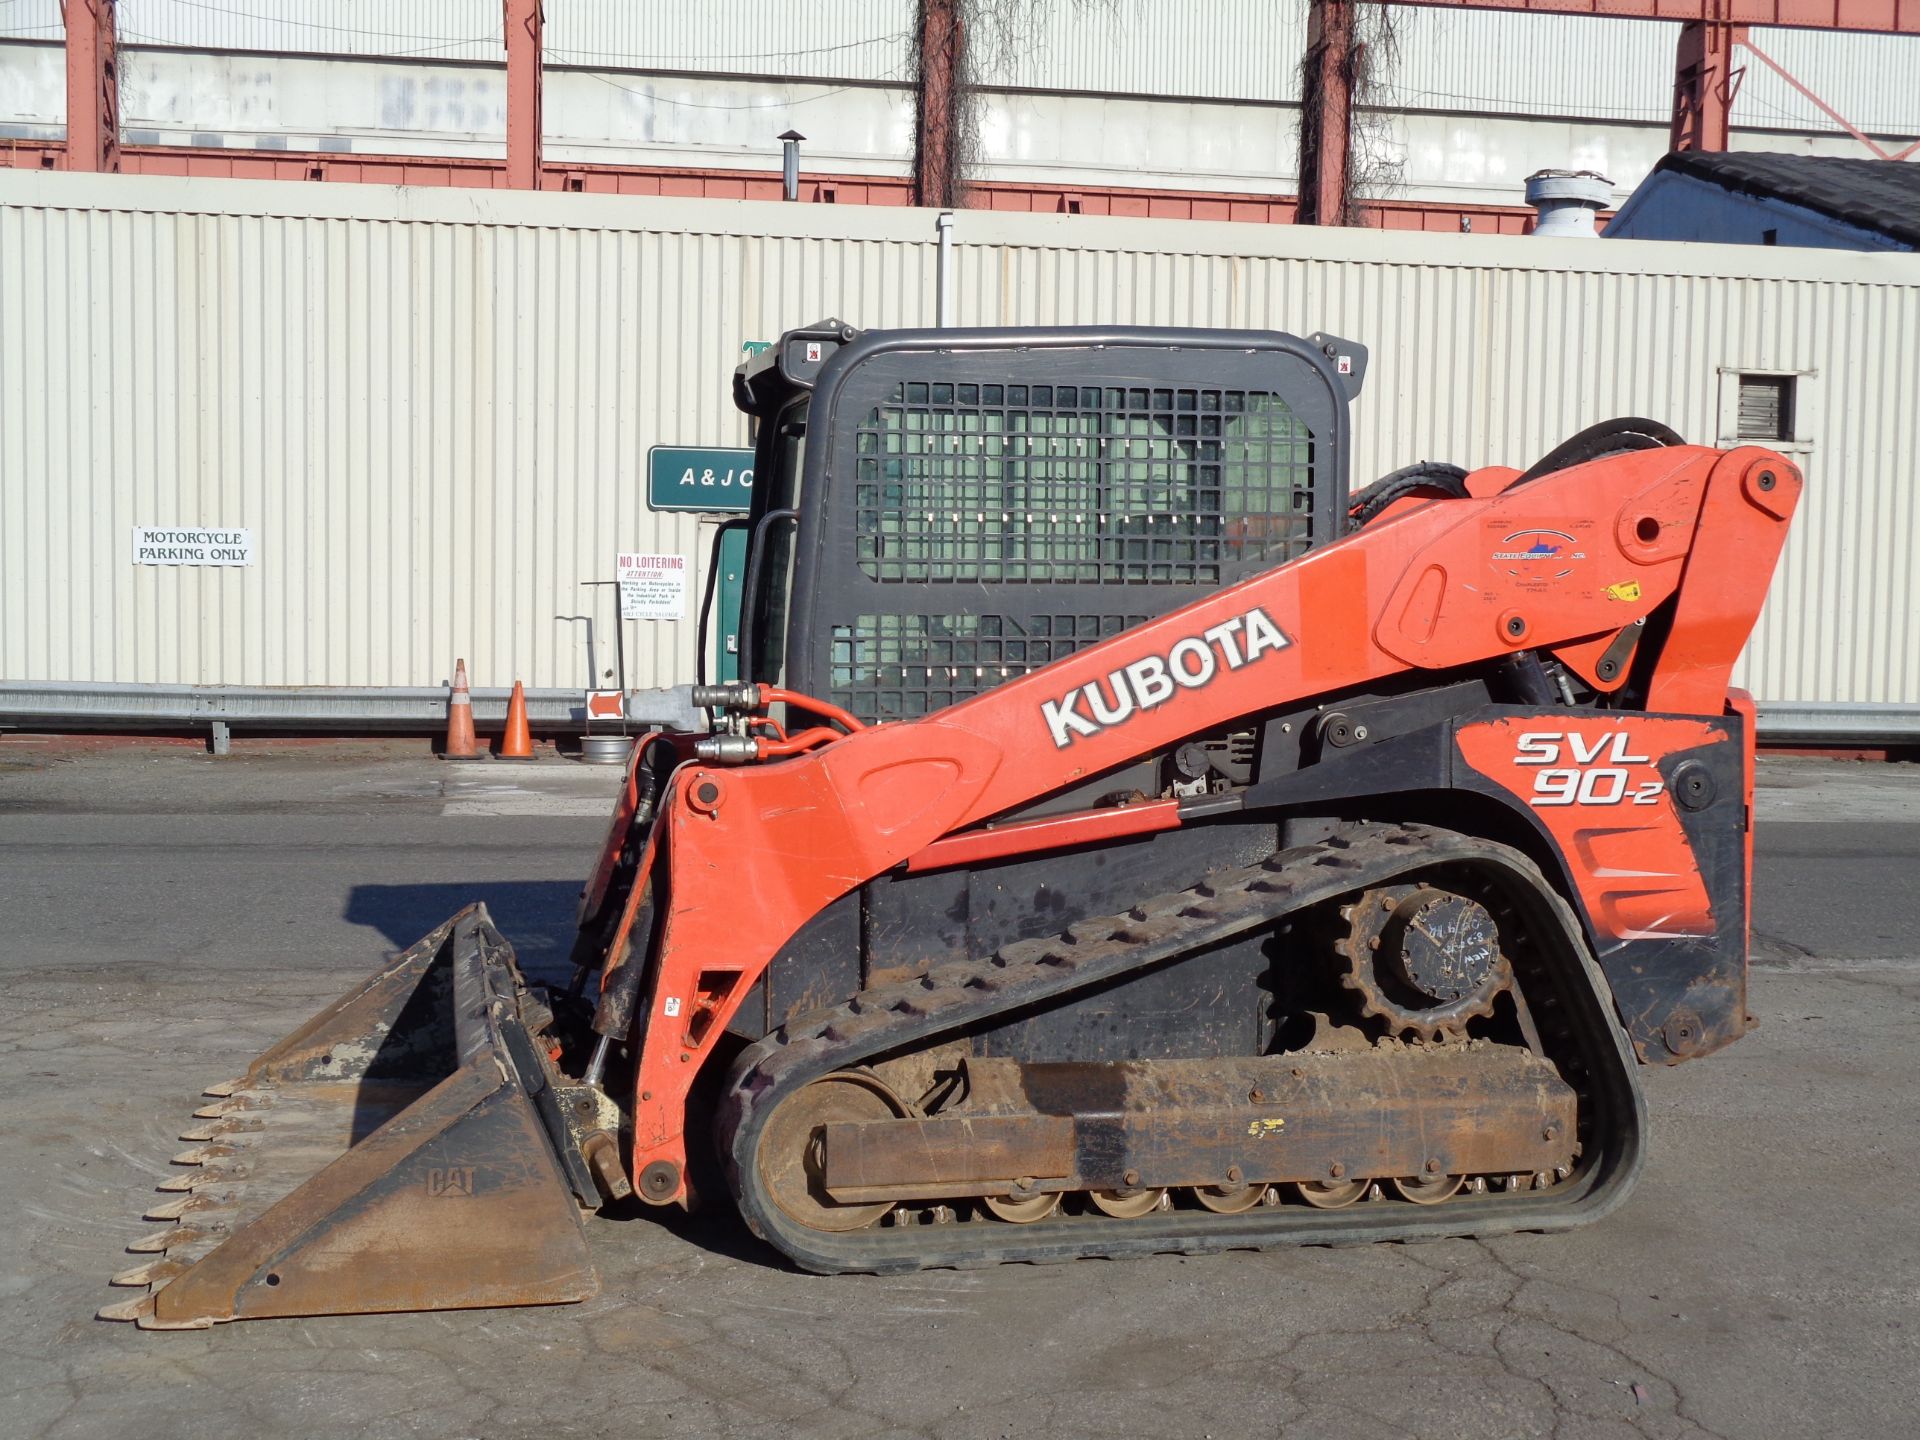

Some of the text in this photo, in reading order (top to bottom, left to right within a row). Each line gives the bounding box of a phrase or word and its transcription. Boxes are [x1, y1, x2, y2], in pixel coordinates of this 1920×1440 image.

[143, 532, 242, 544] MOTORCYCLE
[139, 547, 248, 560] PARKING ONLY
[619, 556, 684, 569] NO LOITERING
[1040, 607, 1290, 749] KUBOTA
[1512, 732, 1650, 764] SVL
[1529, 768, 1664, 805] 90-2
[427, 1167, 476, 1197] CAT
